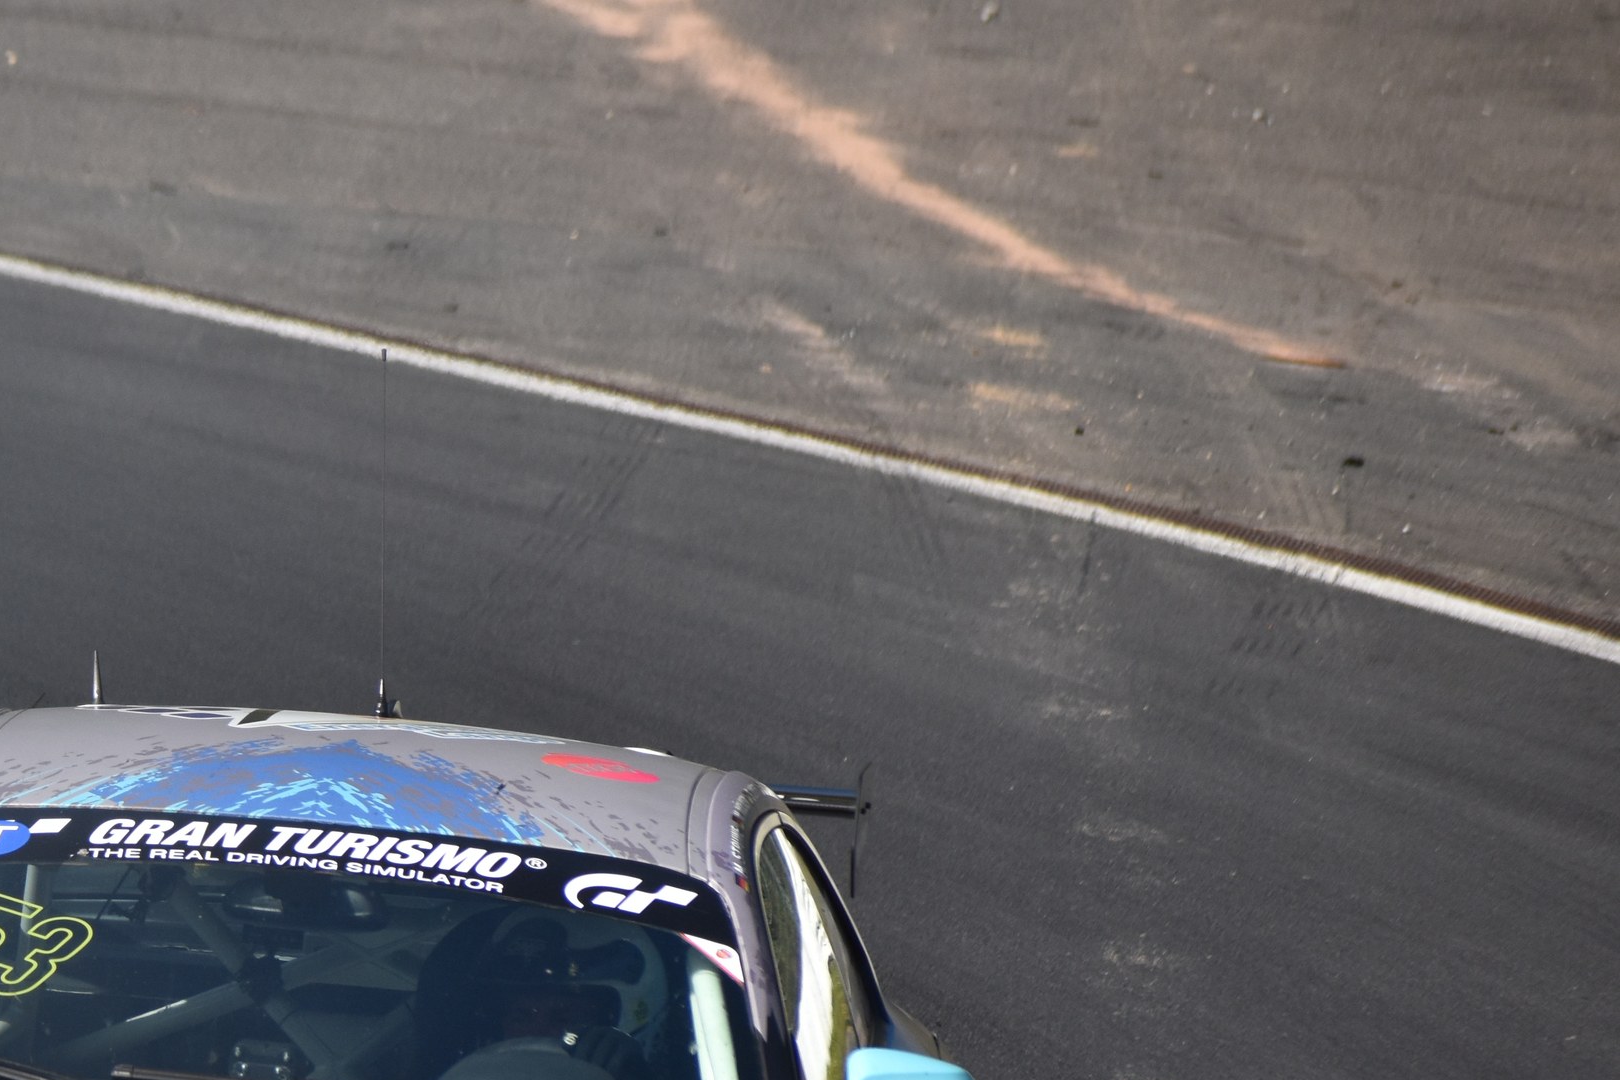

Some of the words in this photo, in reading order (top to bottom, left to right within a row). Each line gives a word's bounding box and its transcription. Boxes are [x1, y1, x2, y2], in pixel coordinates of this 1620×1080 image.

[88, 818, 255, 850] GRAN
[88, 847, 141, 861] THE
[149, 848, 219, 863] REAL
[227, 852, 338, 871] DRIVING
[346, 862, 504, 894] SIMULATOR
